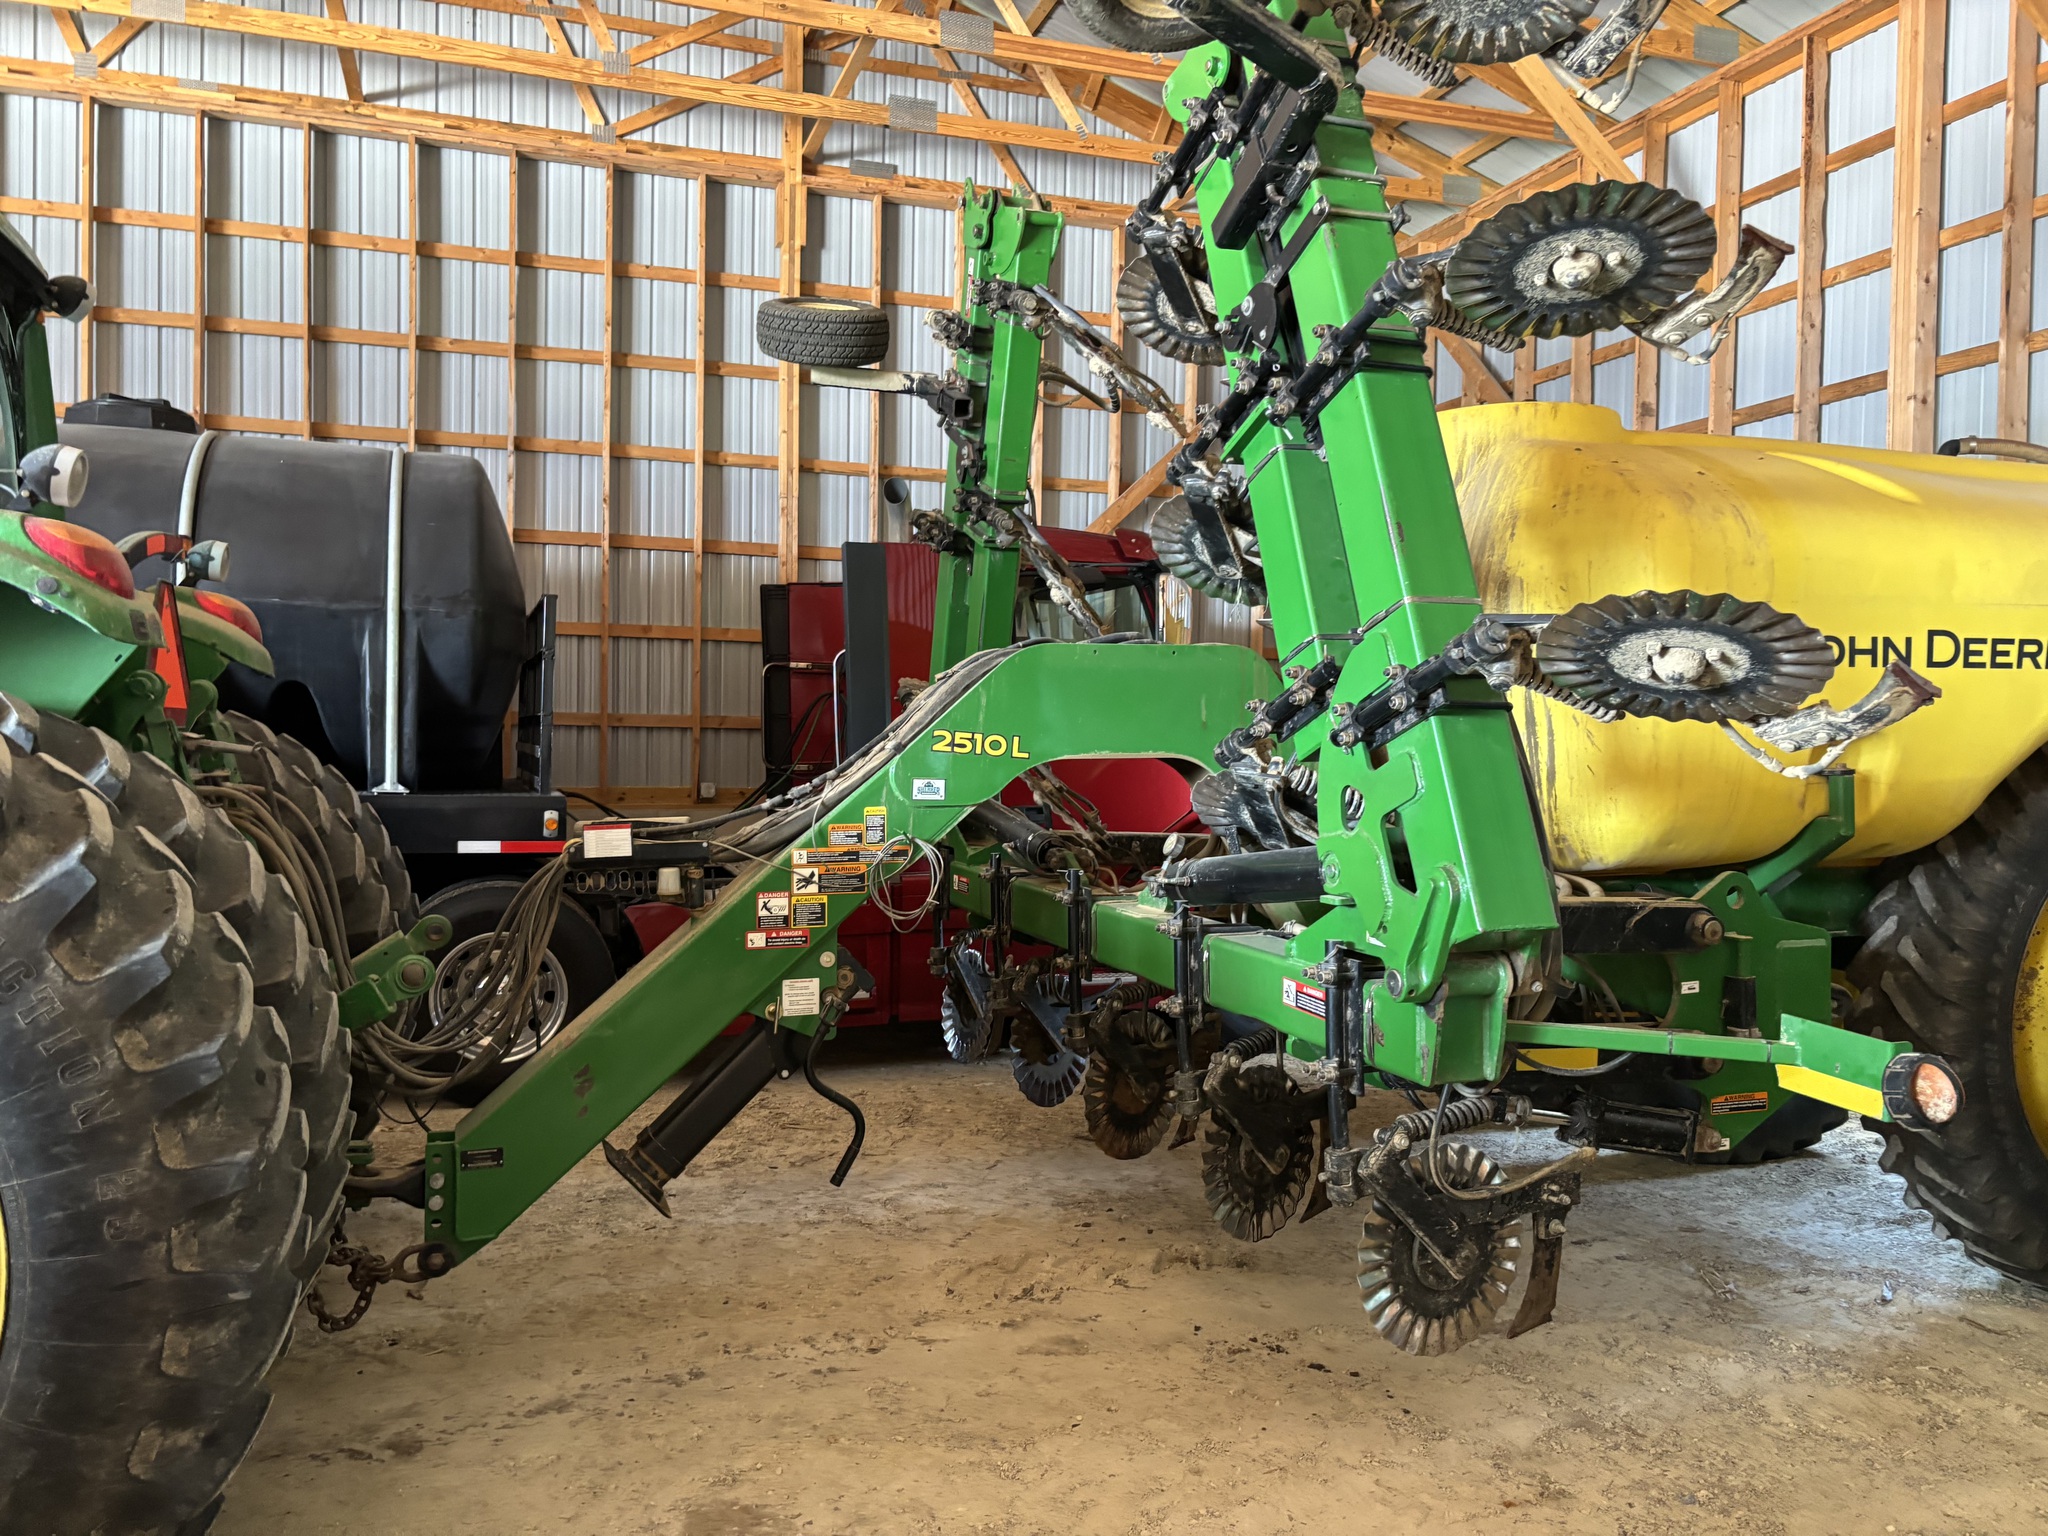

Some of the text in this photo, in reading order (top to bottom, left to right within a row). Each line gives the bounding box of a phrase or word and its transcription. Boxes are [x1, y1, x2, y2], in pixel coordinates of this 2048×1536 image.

[1823, 629, 2048, 670] OHN DEER
[931, 729, 1030, 759] 2510L
[0, 935, 120, 1130] CTION
